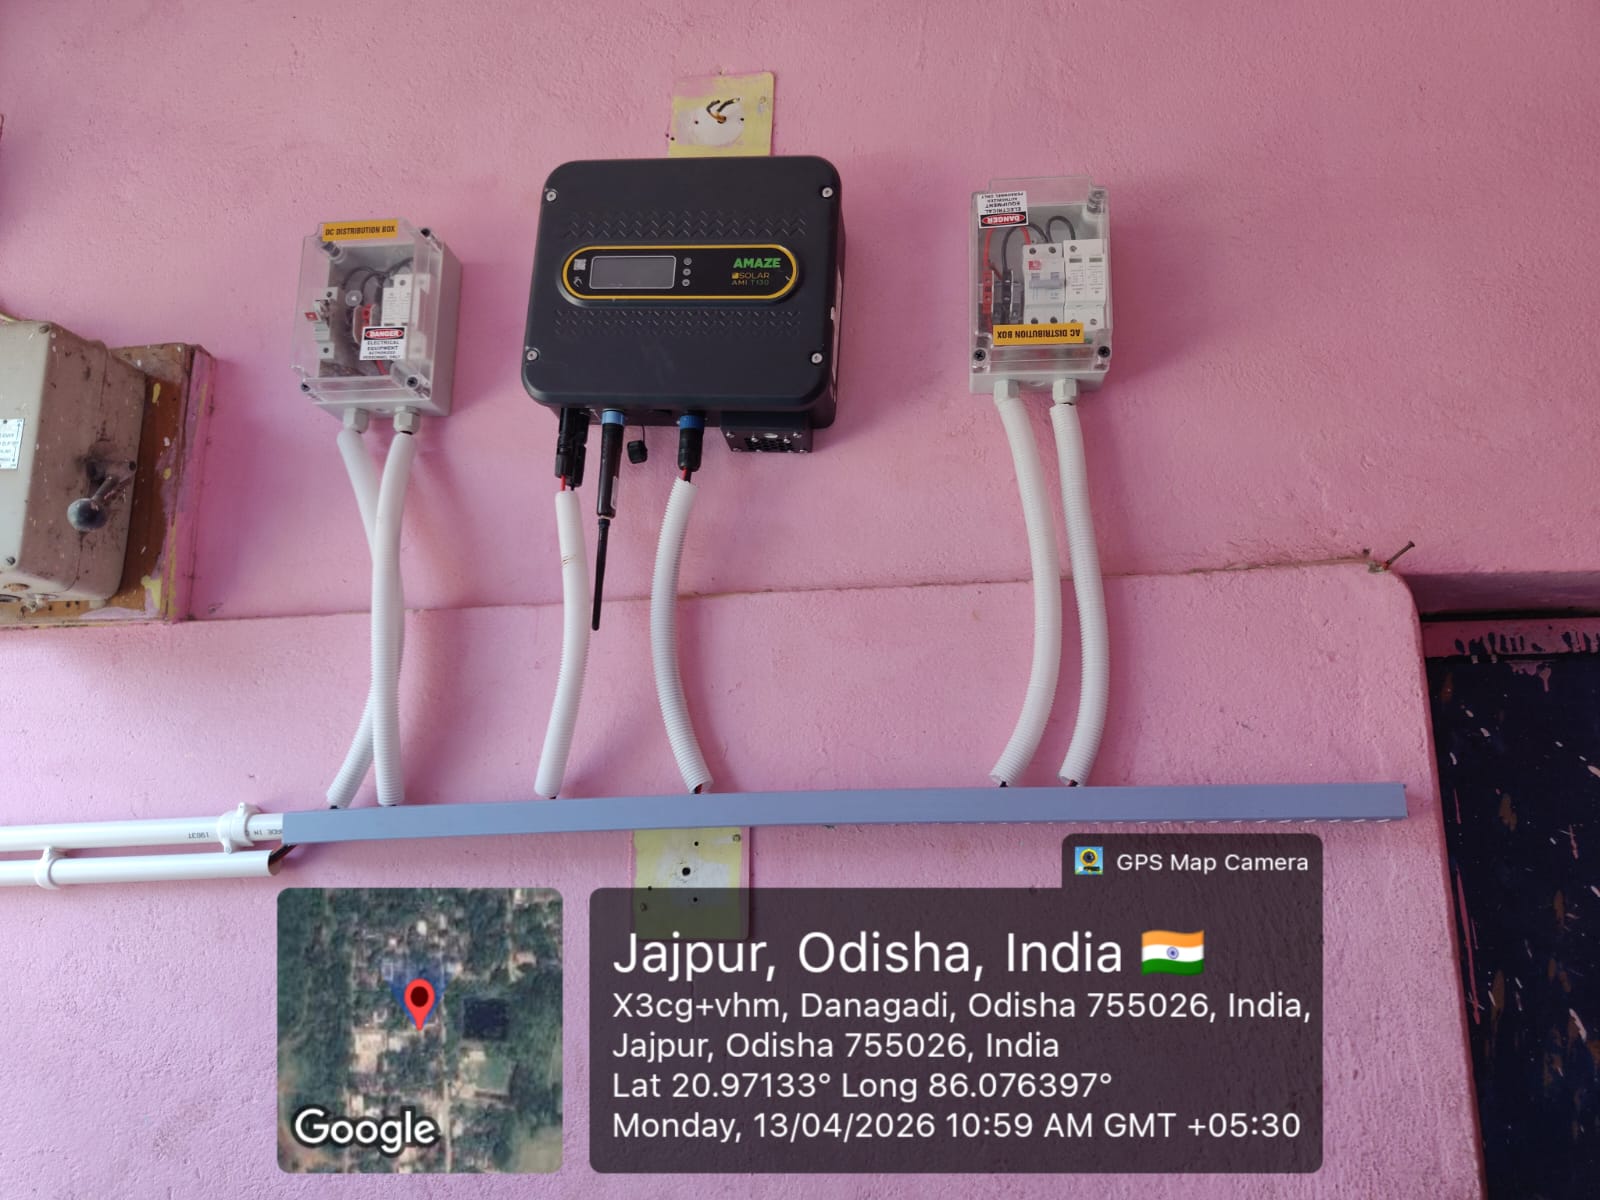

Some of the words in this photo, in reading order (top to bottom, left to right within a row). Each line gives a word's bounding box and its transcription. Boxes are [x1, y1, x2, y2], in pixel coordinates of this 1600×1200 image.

[987, 215, 1020, 224] DANGER
[325, 228, 335, 236] DC
[336, 225, 381, 236] DISTRIBUTION
[381, 225, 396, 233] BOX
[733, 257, 782, 269] AMAZE
[370, 330, 398, 338] DANGER
[997, 330, 1013, 339] BOX
[1015, 328, 1068, 339] DISTRIBUTION
[1069, 328, 1081, 337] AC
